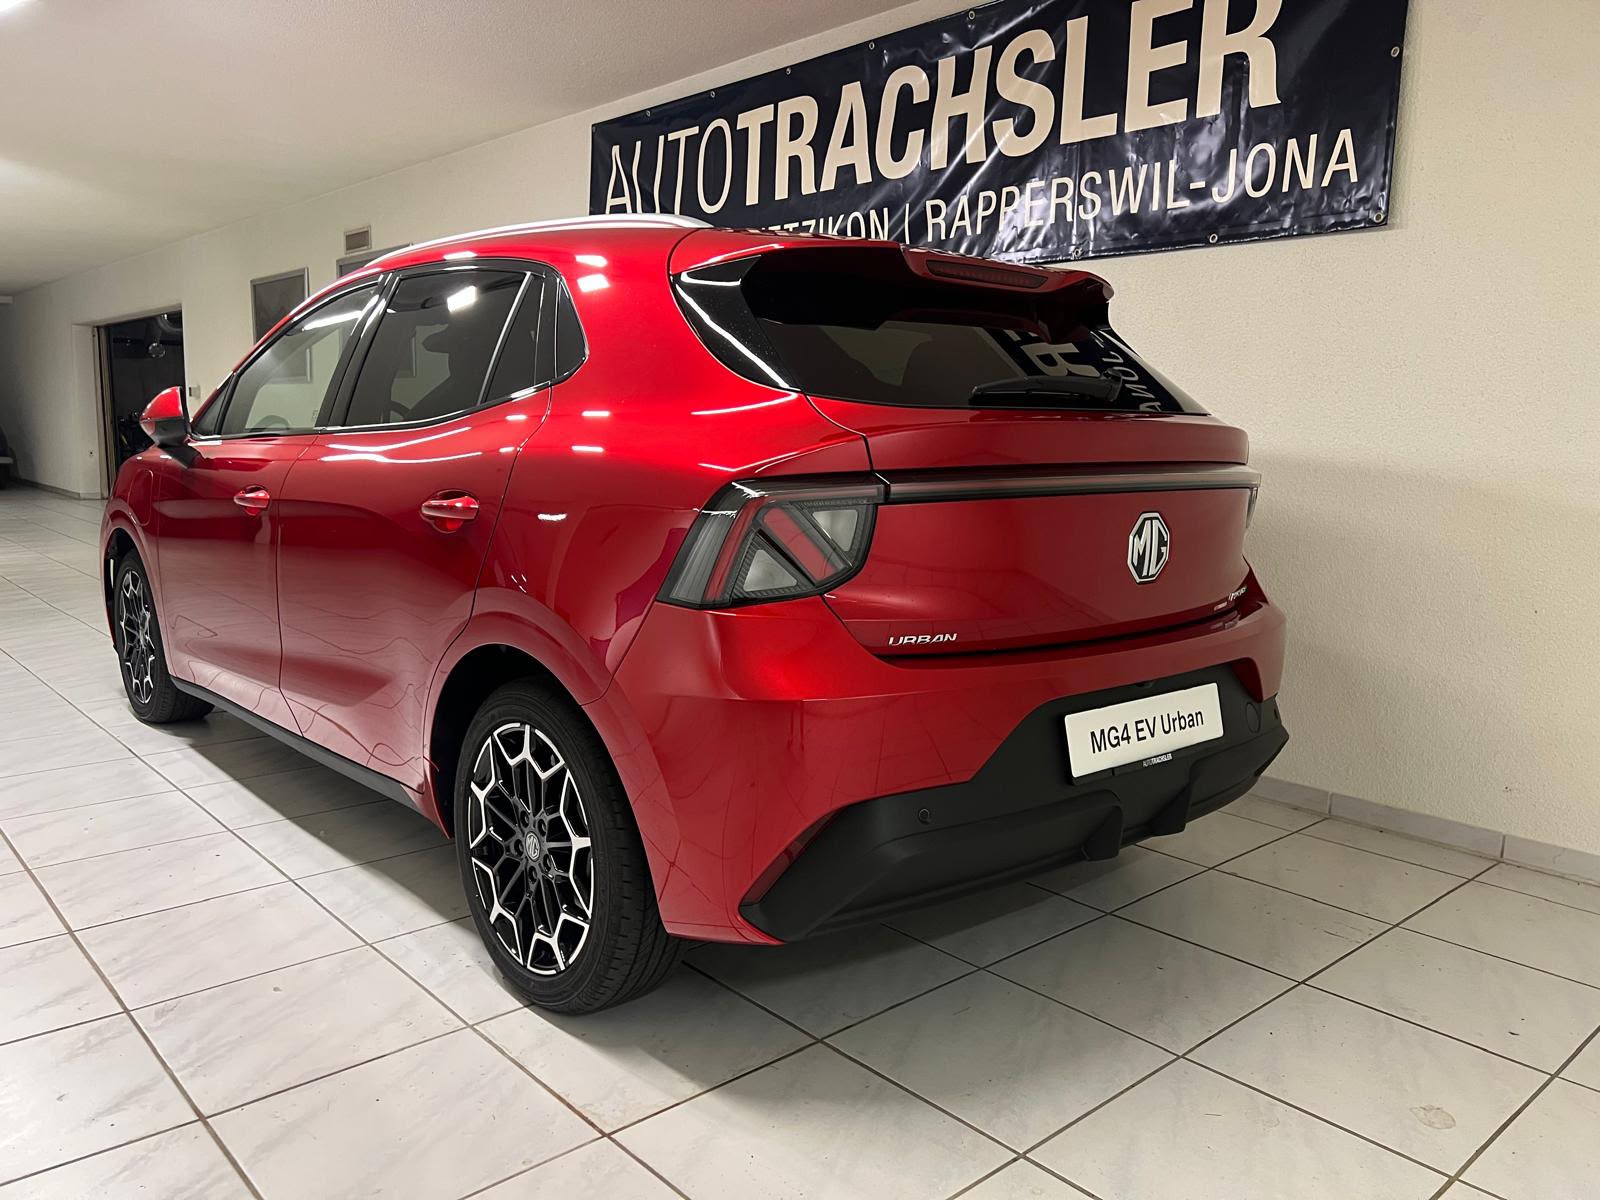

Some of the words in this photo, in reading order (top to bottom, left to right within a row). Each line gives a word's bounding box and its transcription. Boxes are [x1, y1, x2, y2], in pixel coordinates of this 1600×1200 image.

[605, 0, 1282, 216] AUTOTRACHSLER
[761, 207, 889, 241] IKON
[925, 128, 1359, 242] RAPPERSWIL-JONA
[1131, 518, 1168, 578] MG
[888, 632, 958, 646] URBAN
[1090, 723, 1132, 754] MG4
[1134, 716, 1157, 742] EV
[1161, 710, 1204, 735] Urban
